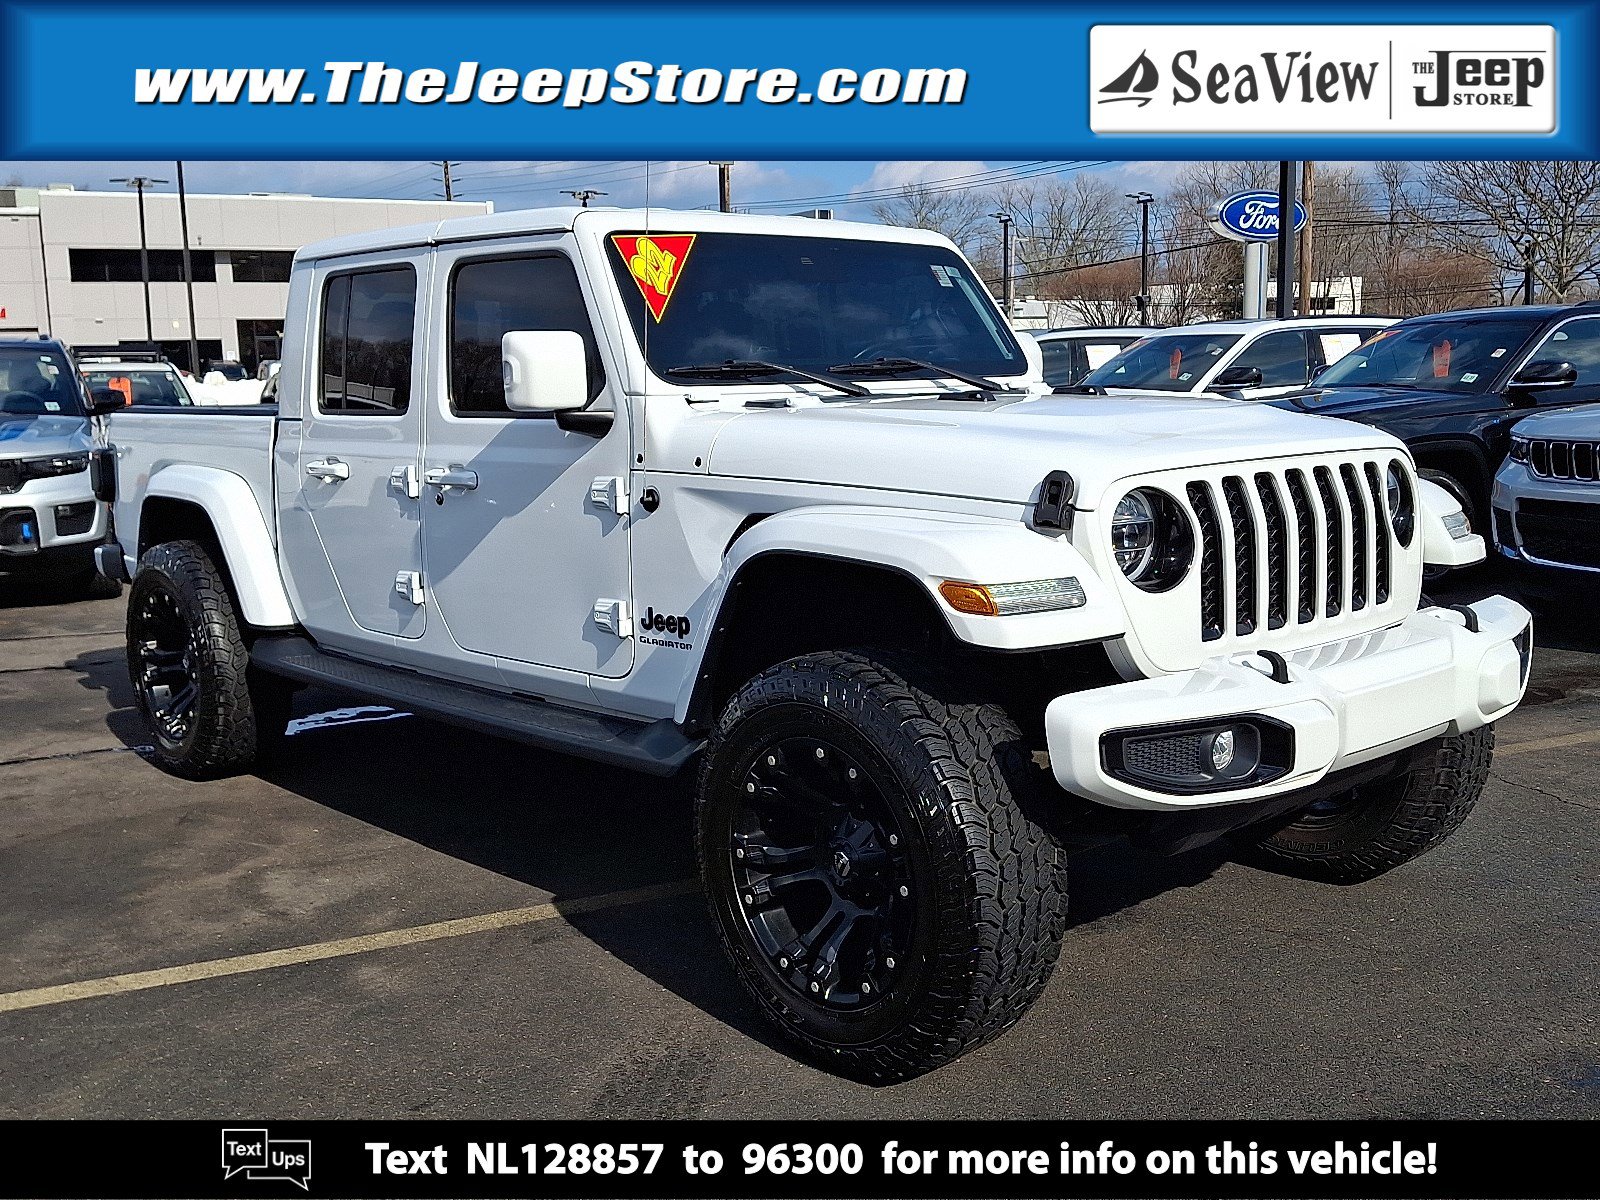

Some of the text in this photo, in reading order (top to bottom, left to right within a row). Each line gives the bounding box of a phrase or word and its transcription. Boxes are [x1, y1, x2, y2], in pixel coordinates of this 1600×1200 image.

[1239, 200, 1280, 230] For
[640, 606, 691, 640] Jeep
[639, 635, 693, 650] GLADIATOR
